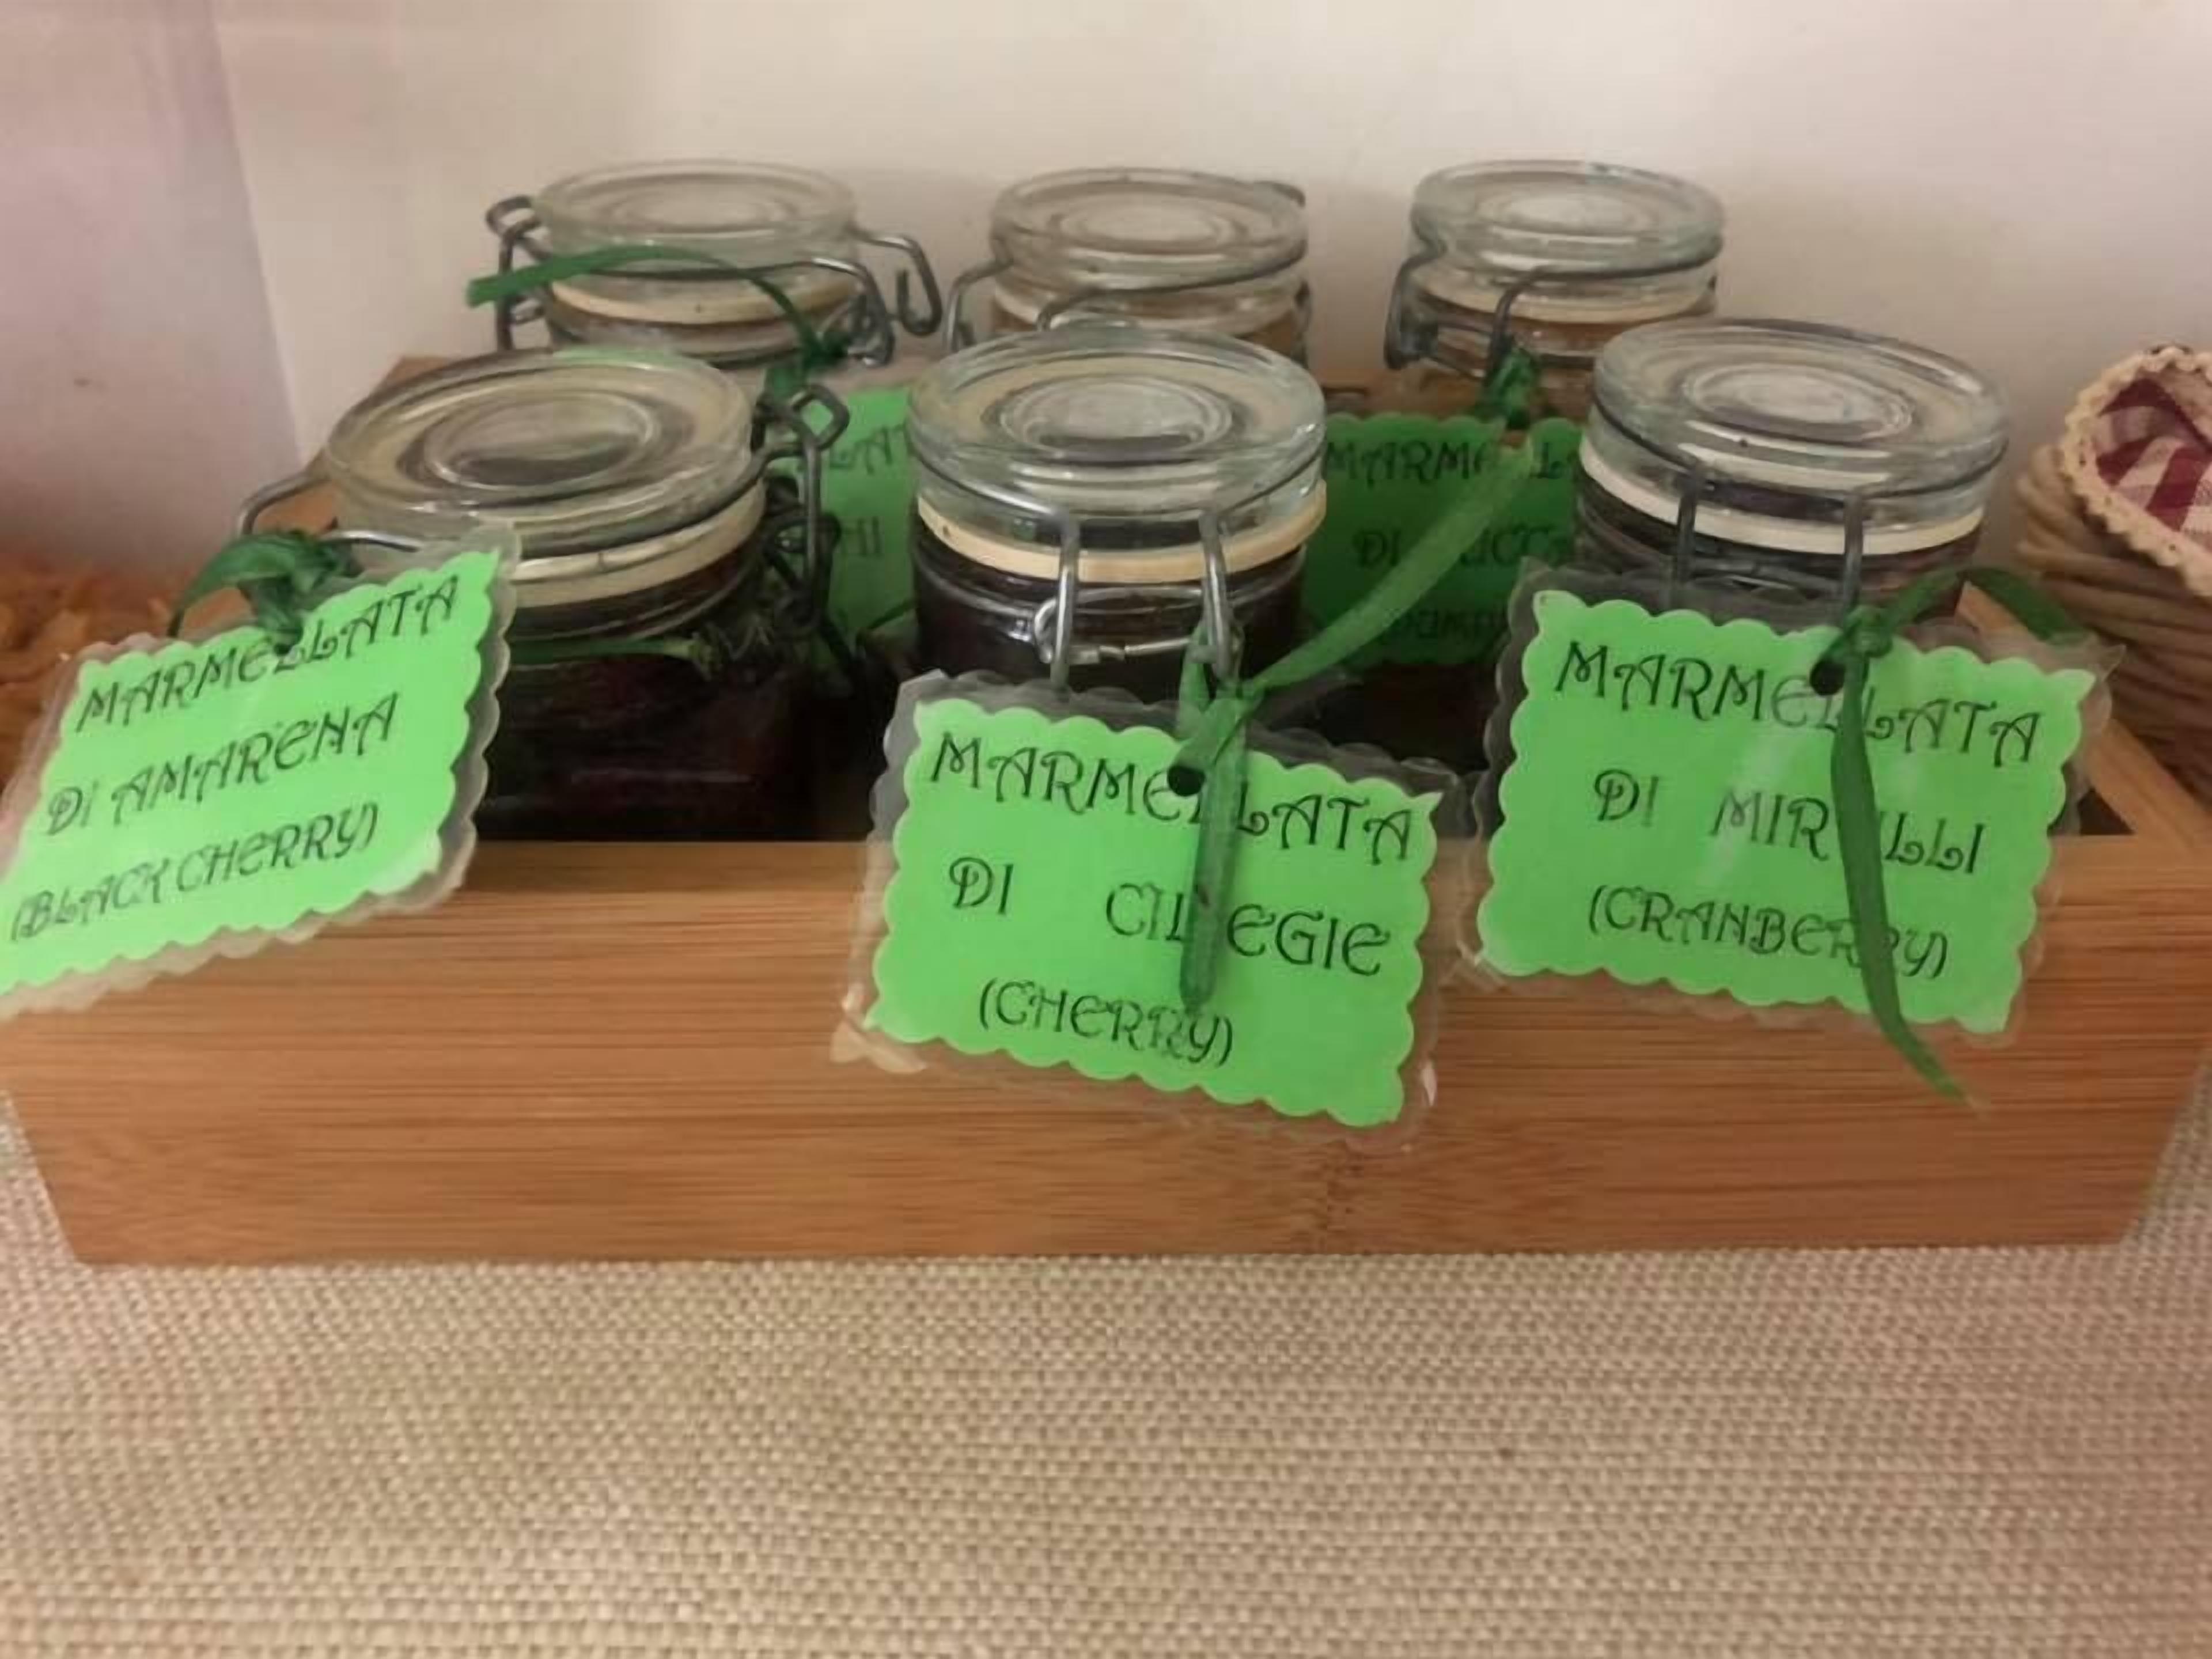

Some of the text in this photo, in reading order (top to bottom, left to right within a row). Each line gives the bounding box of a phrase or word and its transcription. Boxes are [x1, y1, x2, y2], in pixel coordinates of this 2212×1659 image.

[111, 692, 399, 825] AMARENA
[930, 730, 1414, 865] MARMELATA
[176, 802, 380, 892] CHERRY)
[1593, 768, 1986, 874] DI MIRLLI
[948, 857, 1390, 976] DI CILEGIE
[979, 978, 1233, 1067] (CHERRY)
